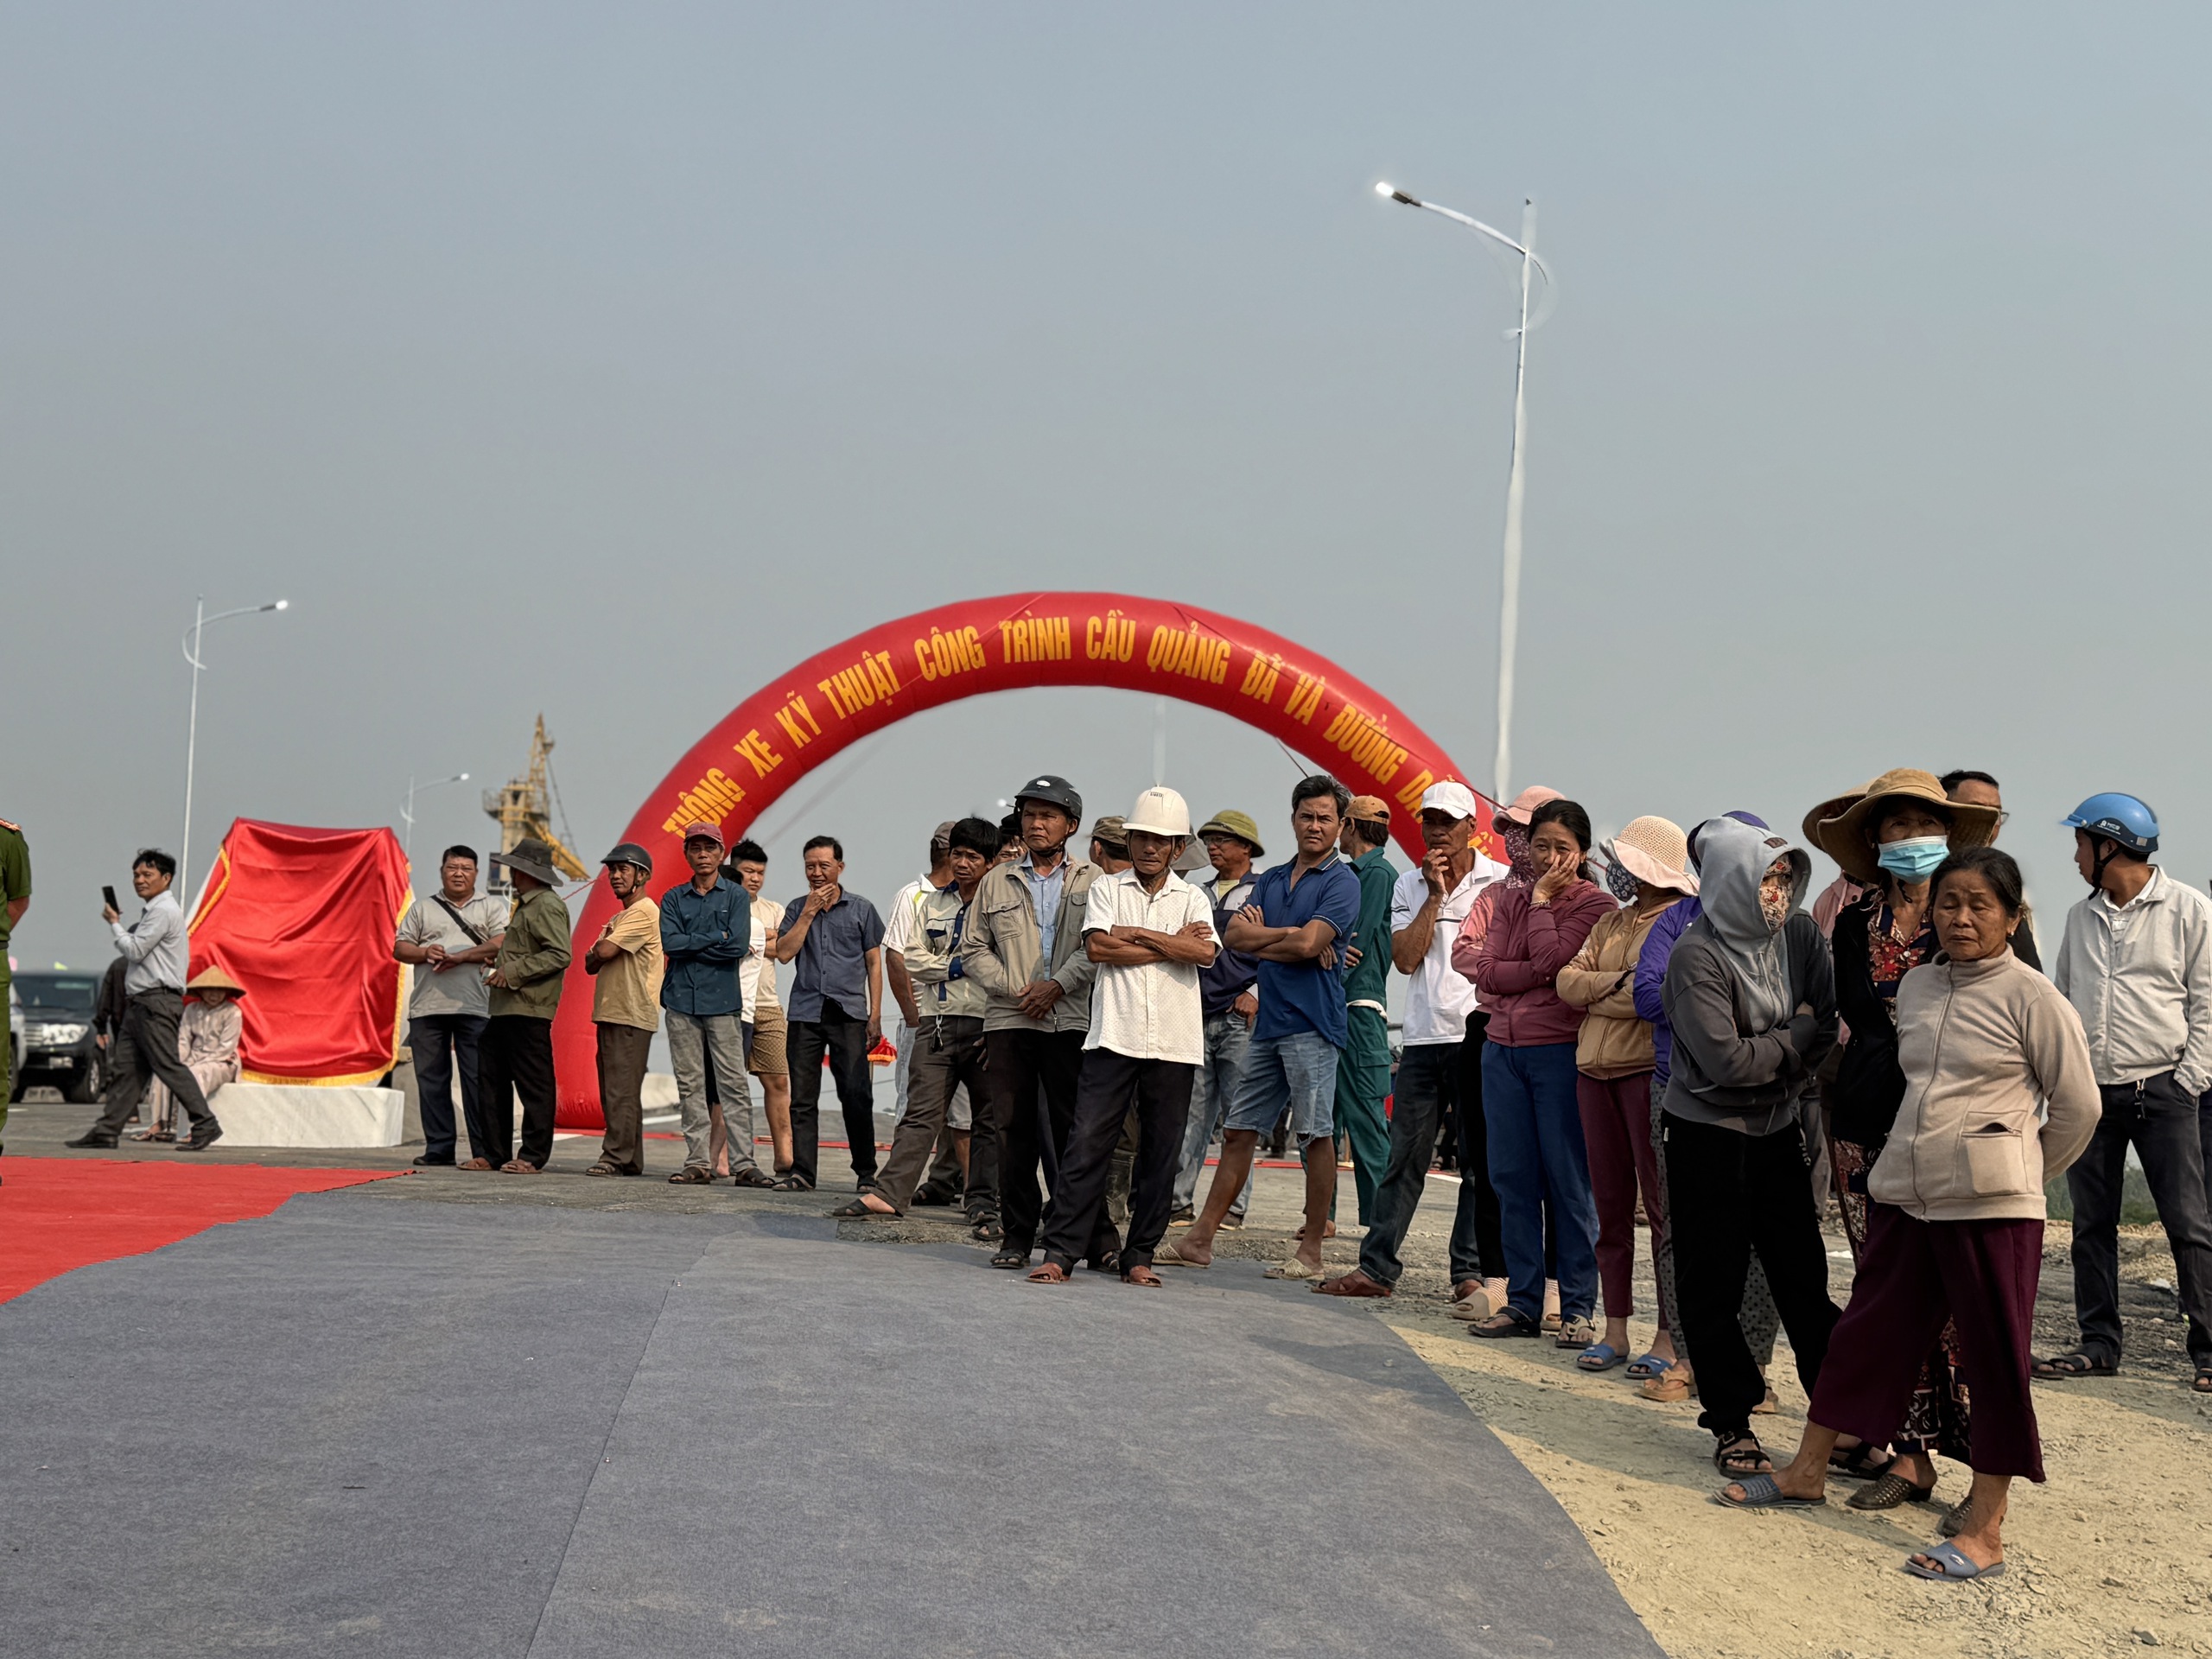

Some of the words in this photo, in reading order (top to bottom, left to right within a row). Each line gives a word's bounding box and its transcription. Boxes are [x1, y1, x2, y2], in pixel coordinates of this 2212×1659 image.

[733, 728, 784, 779] XE
[774, 690, 822, 749] KỸ
[817, 651, 901, 720] THUẬT
[914, 626, 987, 682] CÔNG
[999, 610, 1071, 664] TRÌNH
[1086, 609, 1136, 663] CẦU
[1147, 620, 1231, 684] QUẢNG
[1283, 674, 1325, 725] VÀ
[1322, 703, 1409, 785] ĐƯỜNG
